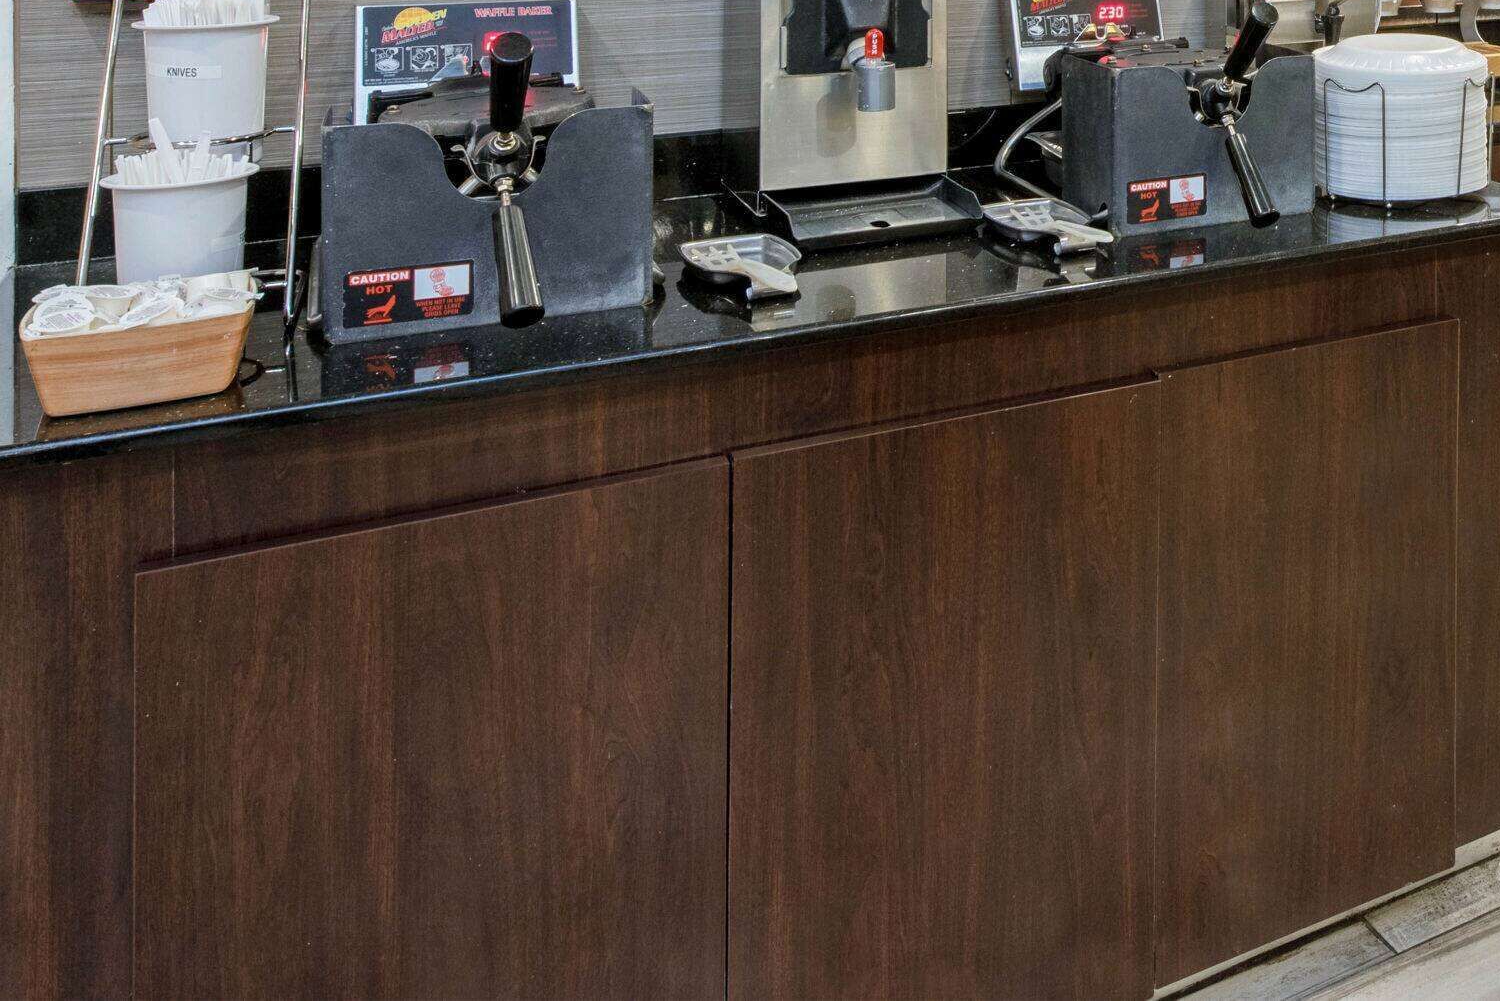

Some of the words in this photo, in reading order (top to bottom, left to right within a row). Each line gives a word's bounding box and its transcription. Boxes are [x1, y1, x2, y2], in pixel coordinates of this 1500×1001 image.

[474, 7, 515, 18] WAFFLE
[166, 67, 198, 78] KNIVES
[1130, 180, 1168, 192] CAUTION
[350, 270, 410, 285] CAUTION
[366, 284, 393, 295] HOT
